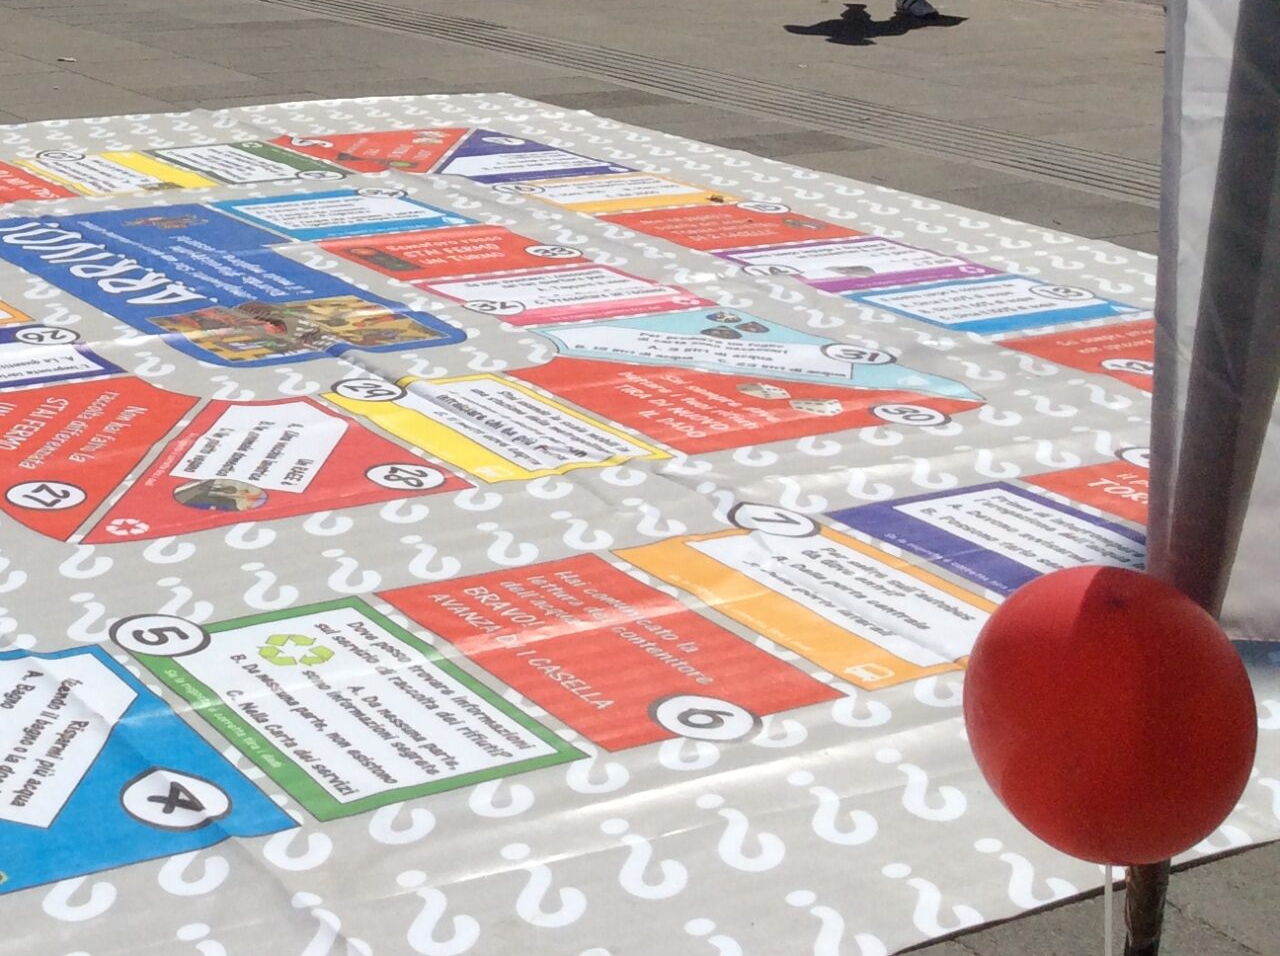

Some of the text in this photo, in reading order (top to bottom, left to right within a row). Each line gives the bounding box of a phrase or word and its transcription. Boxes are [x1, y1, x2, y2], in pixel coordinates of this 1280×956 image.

[22, 331, 67, 344] 26
[838, 349, 878, 362] 31
[29, 395, 72, 422] STAI
[882, 403, 938, 424] 30
[18, 390, 124, 474] raccolta differenziata
[68, 404, 149, 466] Non hai fatto la
[383, 466, 428, 487] 28
[1088, 477, 1149, 504] TOR
[22, 484, 70, 507] 27
[461, 586, 547, 629] BRAVO!
[525, 576, 590, 608] lettura
[552, 571, 594, 588] Hai
[673, 642, 707, 654] la
[132, 626, 190, 645] 5
[426, 593, 505, 634] AVANZA
[524, 657, 621, 711] CASELLA
[22, 670, 45, 684] A.
[313, 622, 340, 636] sul
[331, 634, 383, 666] servizio
[387, 676, 445, 711] raccolta
[435, 710, 467, 726] dei
[456, 726, 515, 761] rifiuti?
[345, 621, 538, 751] Dove posso trovare informazioni
[40, 711, 61, 720] il
[229, 654, 251, 664] B.
[241, 664, 265, 675] Da
[289, 706, 337, 733] parte,
[325, 732, 355, 749] non
[345, 748, 403, 786] esistono
[346, 684, 468, 772] A. Da nessuna parte,
[677, 708, 735, 729] 6
[14, 718, 54, 748] bagno
[224, 690, 361, 796] C. Nella Carta dei servizi
[324, 690, 402, 742] informazioni
[385, 741, 445, 777] segrete
[4, 754, 27, 765] la
[5, 717, 91, 808] Risparmi più acqua
[147, 782, 205, 814] 4
